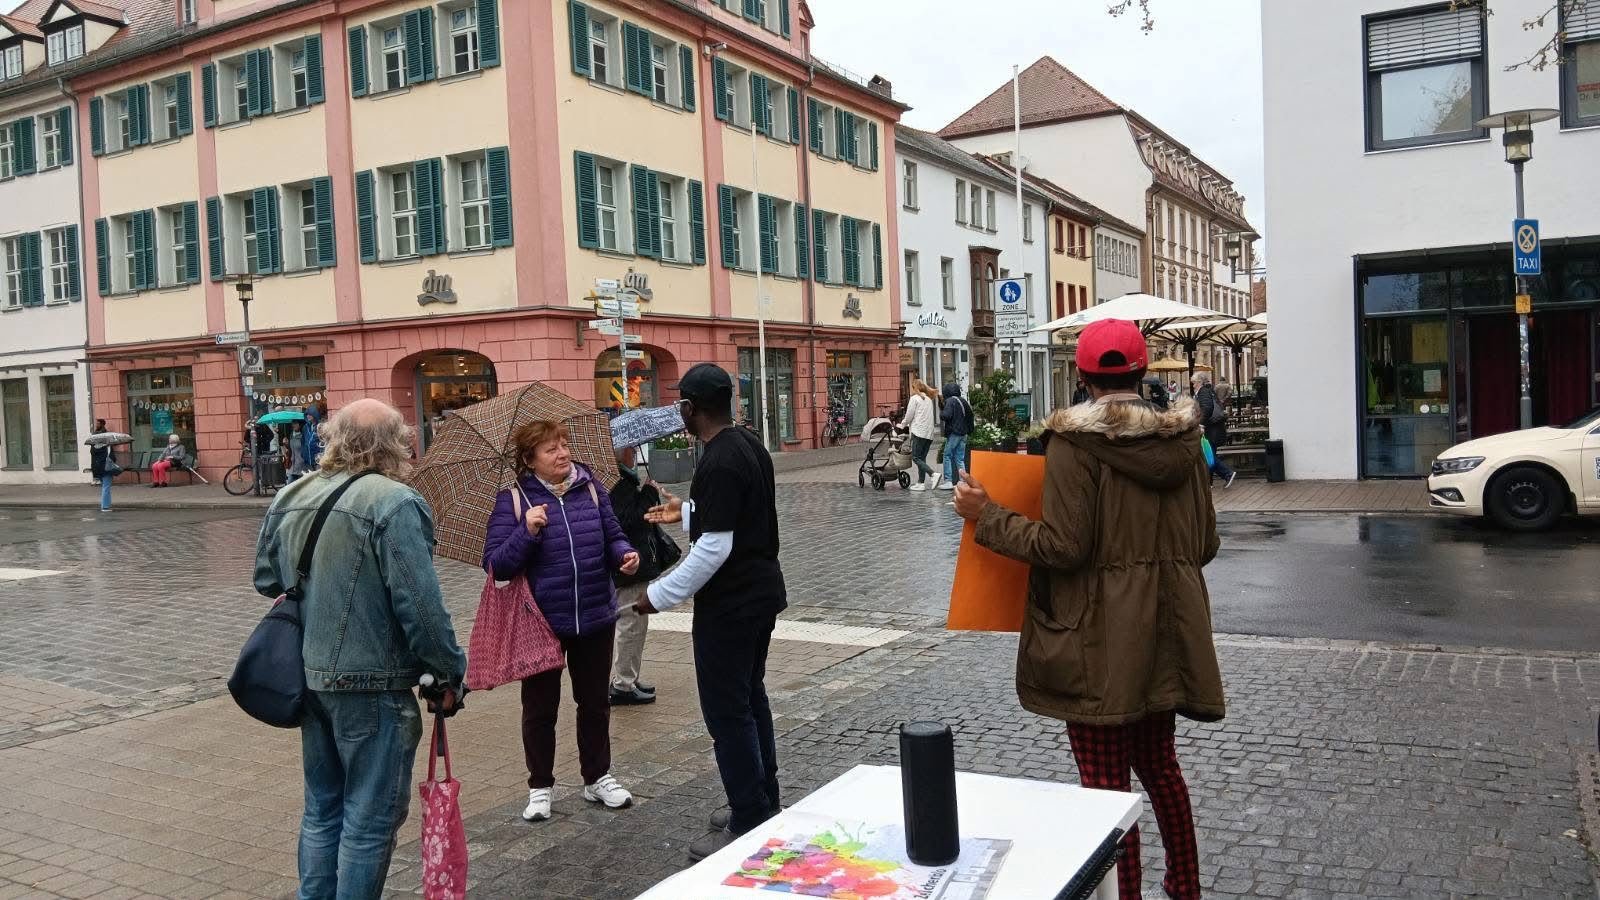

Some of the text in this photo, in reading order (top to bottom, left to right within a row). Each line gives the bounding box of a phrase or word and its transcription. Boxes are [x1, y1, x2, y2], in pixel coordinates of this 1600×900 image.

[1517, 257, 1538, 269] TAXI
[421, 270, 453, 293] dm
[623, 267, 649, 288] dm
